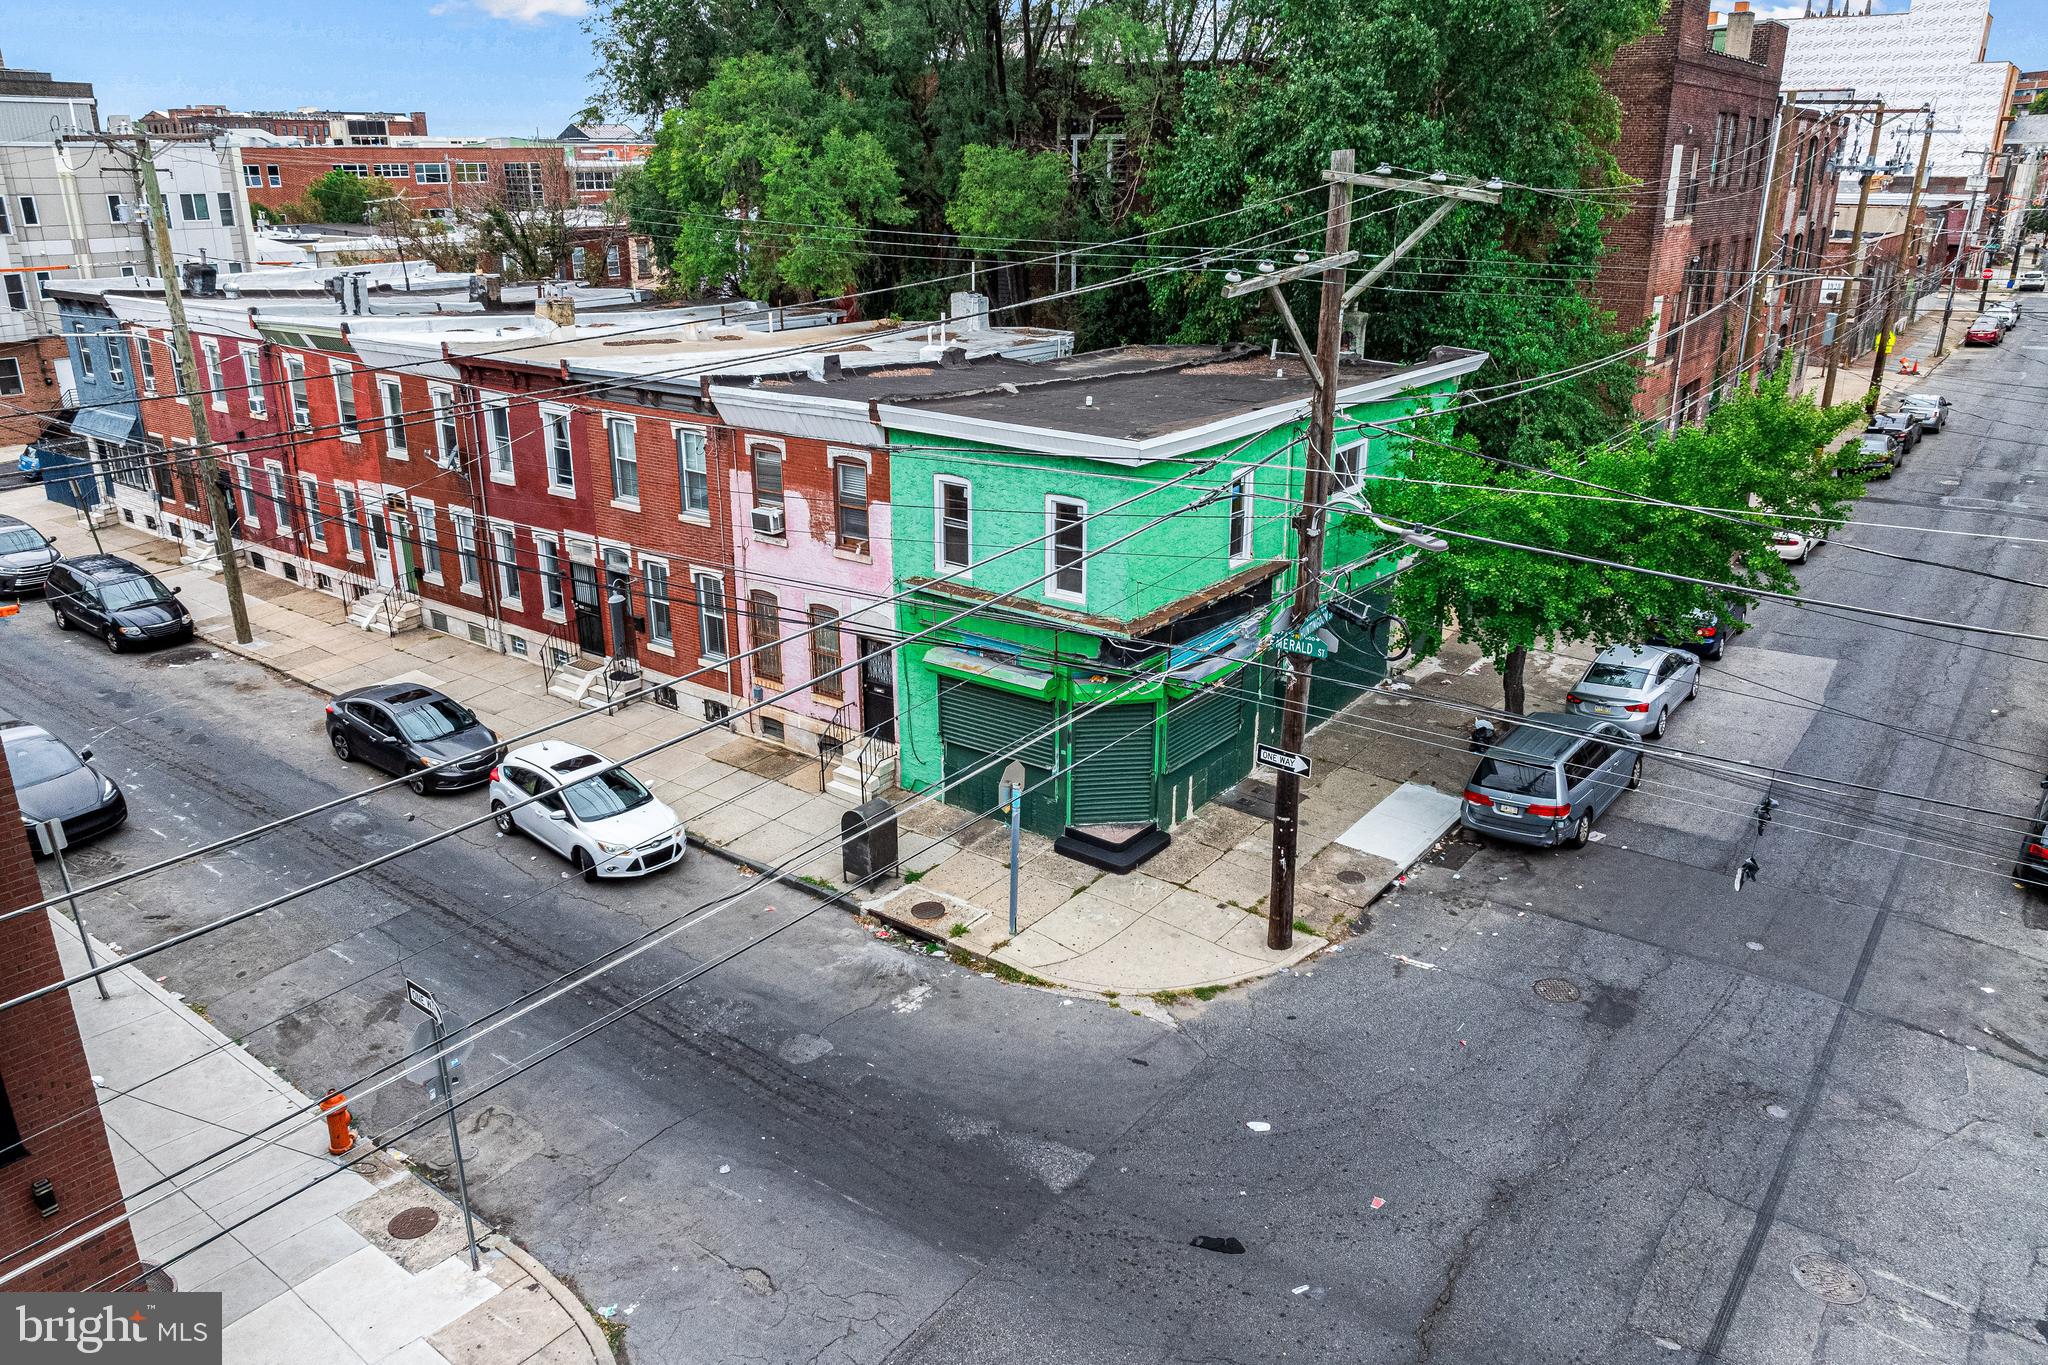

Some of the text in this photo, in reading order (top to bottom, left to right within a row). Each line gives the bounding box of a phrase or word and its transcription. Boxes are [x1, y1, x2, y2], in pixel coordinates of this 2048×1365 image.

[1317, 648, 1326, 657] ST
[1263, 751, 1296, 767] ONE WAY
